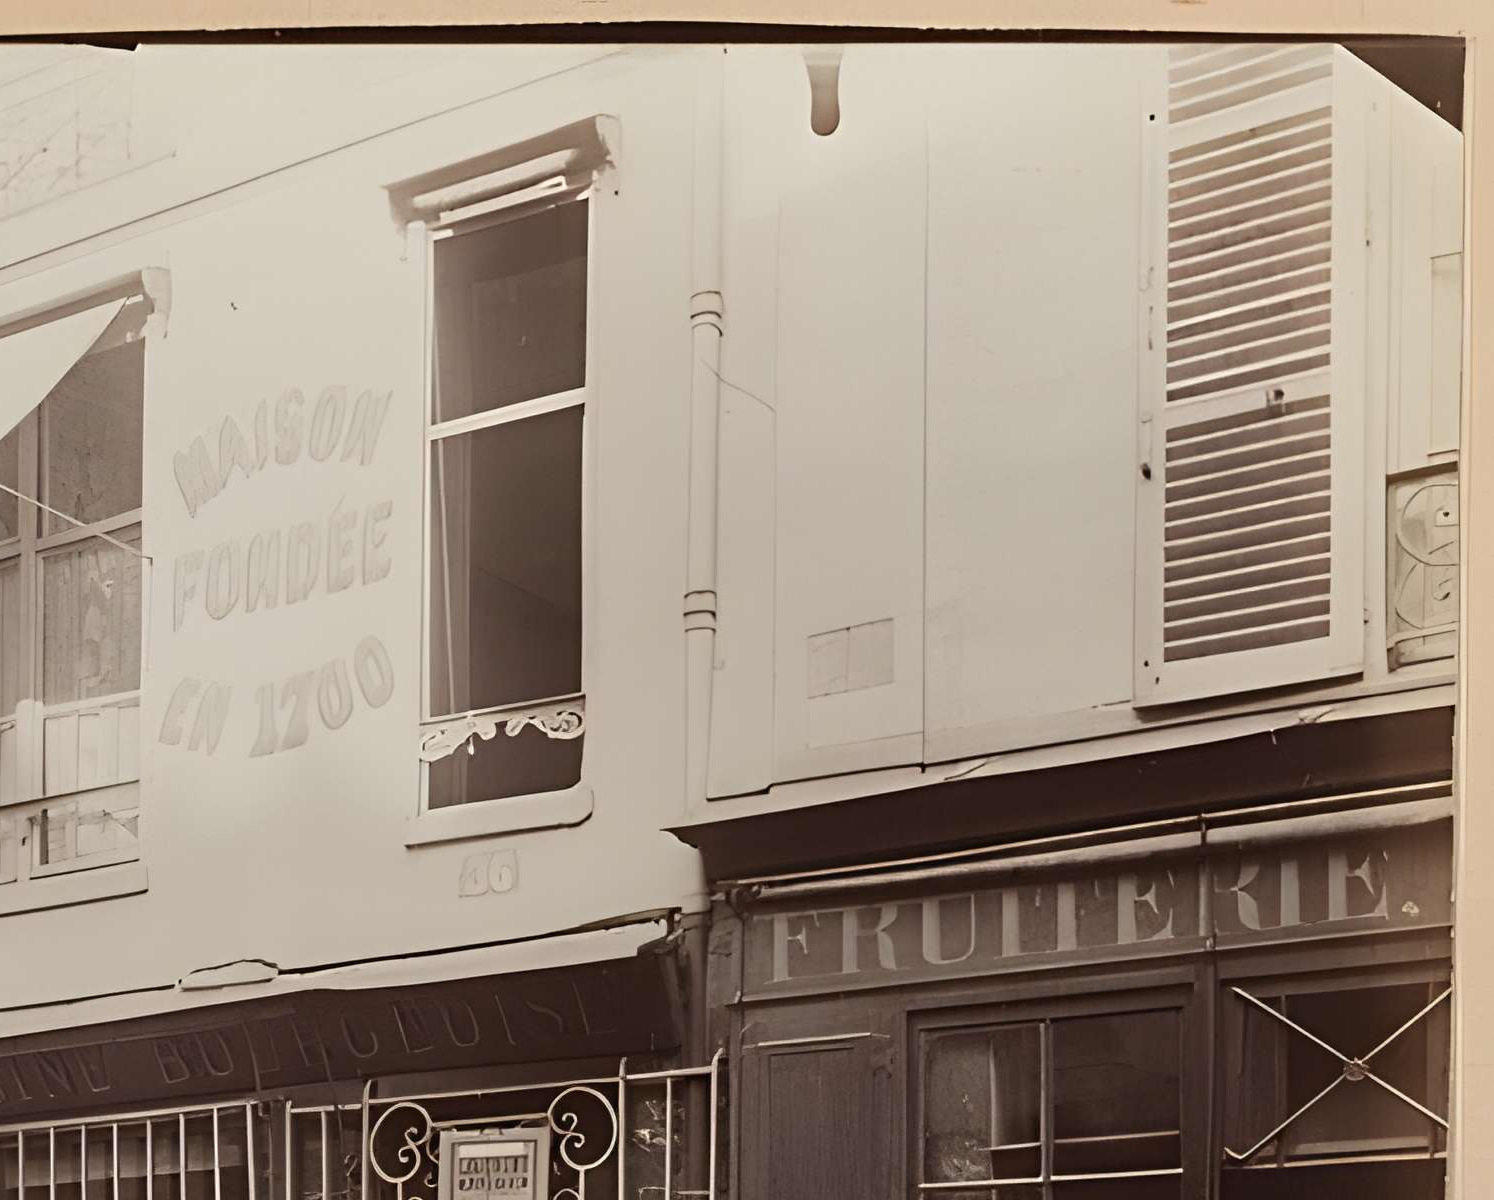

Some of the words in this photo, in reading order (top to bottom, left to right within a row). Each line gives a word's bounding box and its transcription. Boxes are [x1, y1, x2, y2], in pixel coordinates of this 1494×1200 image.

[172, 382, 395, 519] MAISON
[173, 494, 394, 634] FONDÉE
[158, 676, 234, 758] EN
